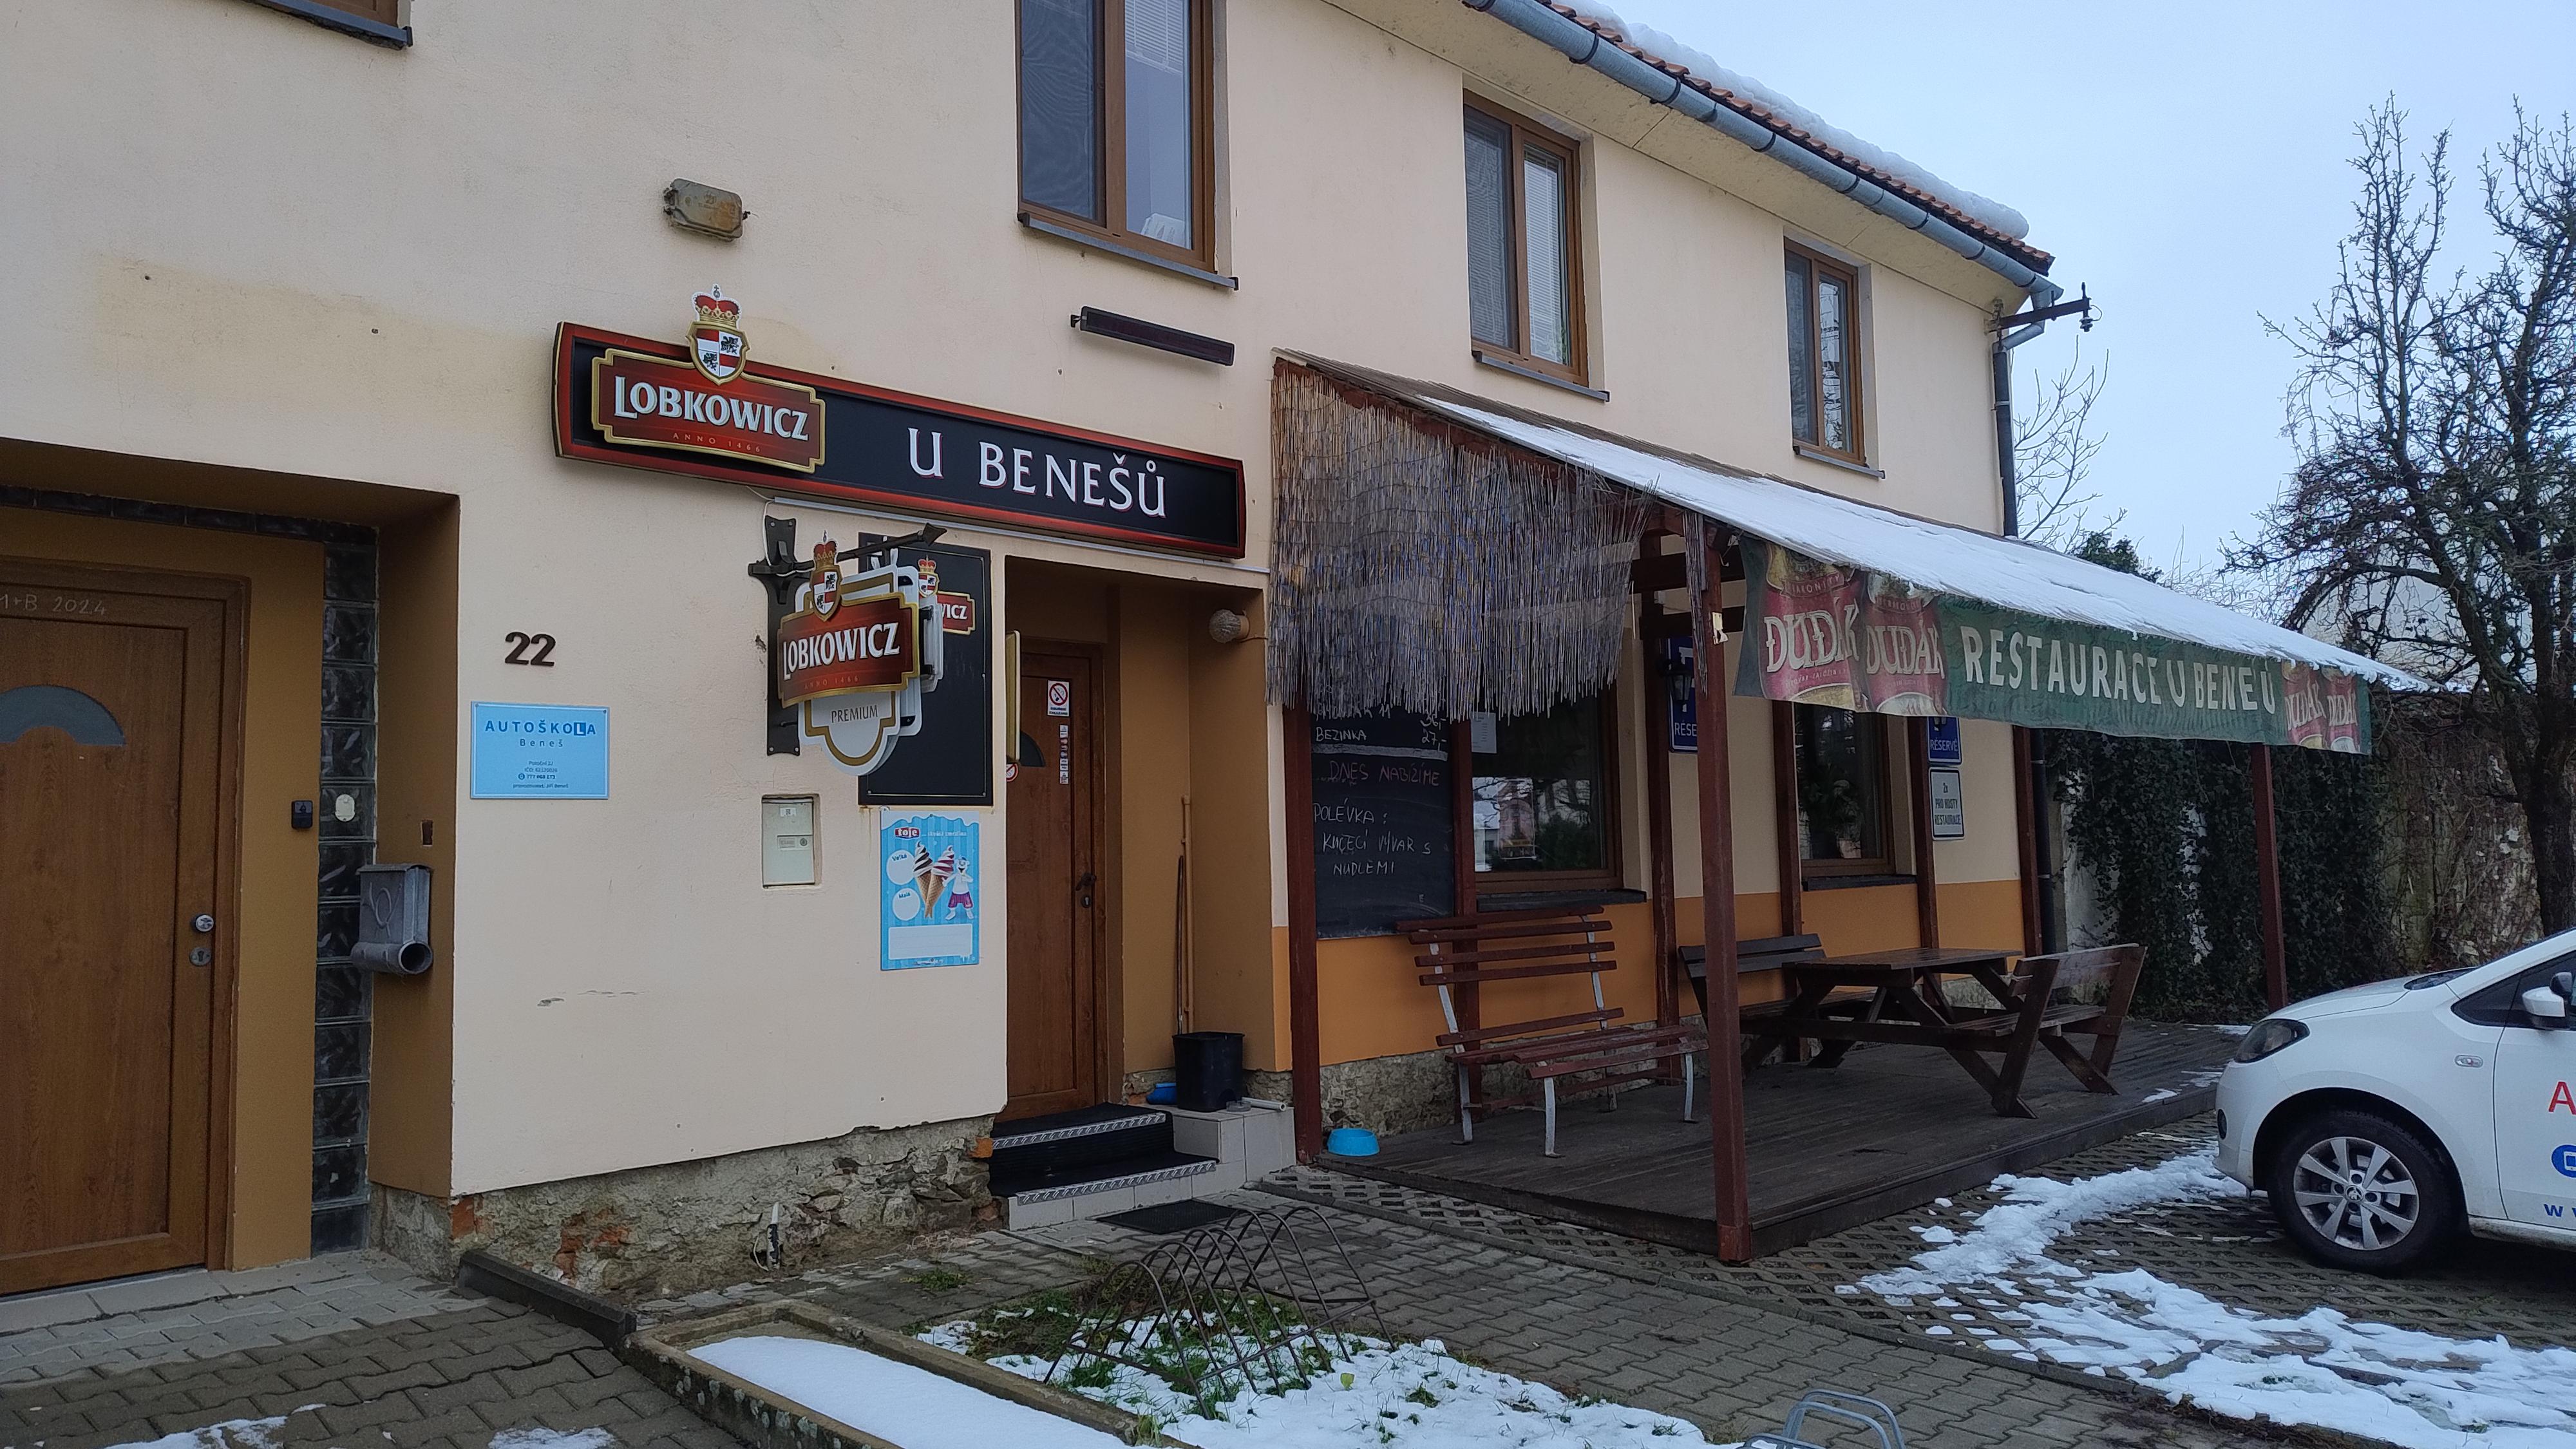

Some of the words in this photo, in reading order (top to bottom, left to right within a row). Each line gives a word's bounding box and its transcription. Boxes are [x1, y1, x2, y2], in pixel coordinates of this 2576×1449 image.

[614, 375, 809, 441] LOBKOWICZ
[673, 432, 716, 444] ANNO
[728, 440, 761, 452] 1466
[908, 428, 943, 478] U
[979, 441, 1166, 517] BENEŠŮ
[52, 596, 107, 616] 2024
[505, 632, 556, 667] 22
[784, 622, 900, 680] LOBKOWICZ
[1960, 626, 2161, 704] RESTAURACE
[2166, 659, 2185, 706] U
[831, 705, 878, 723] PREMIUM
[485, 720, 596, 735] AUTOŠKOLA
[1316, 726, 1367, 742] BEZINKA
[520, 739, 564, 748] Beneš
[1929, 738, 1958, 752] RÉSERVÉ
[1329, 760, 1368, 781] DNES
[1313, 798, 1375, 824] POLÉVKA
